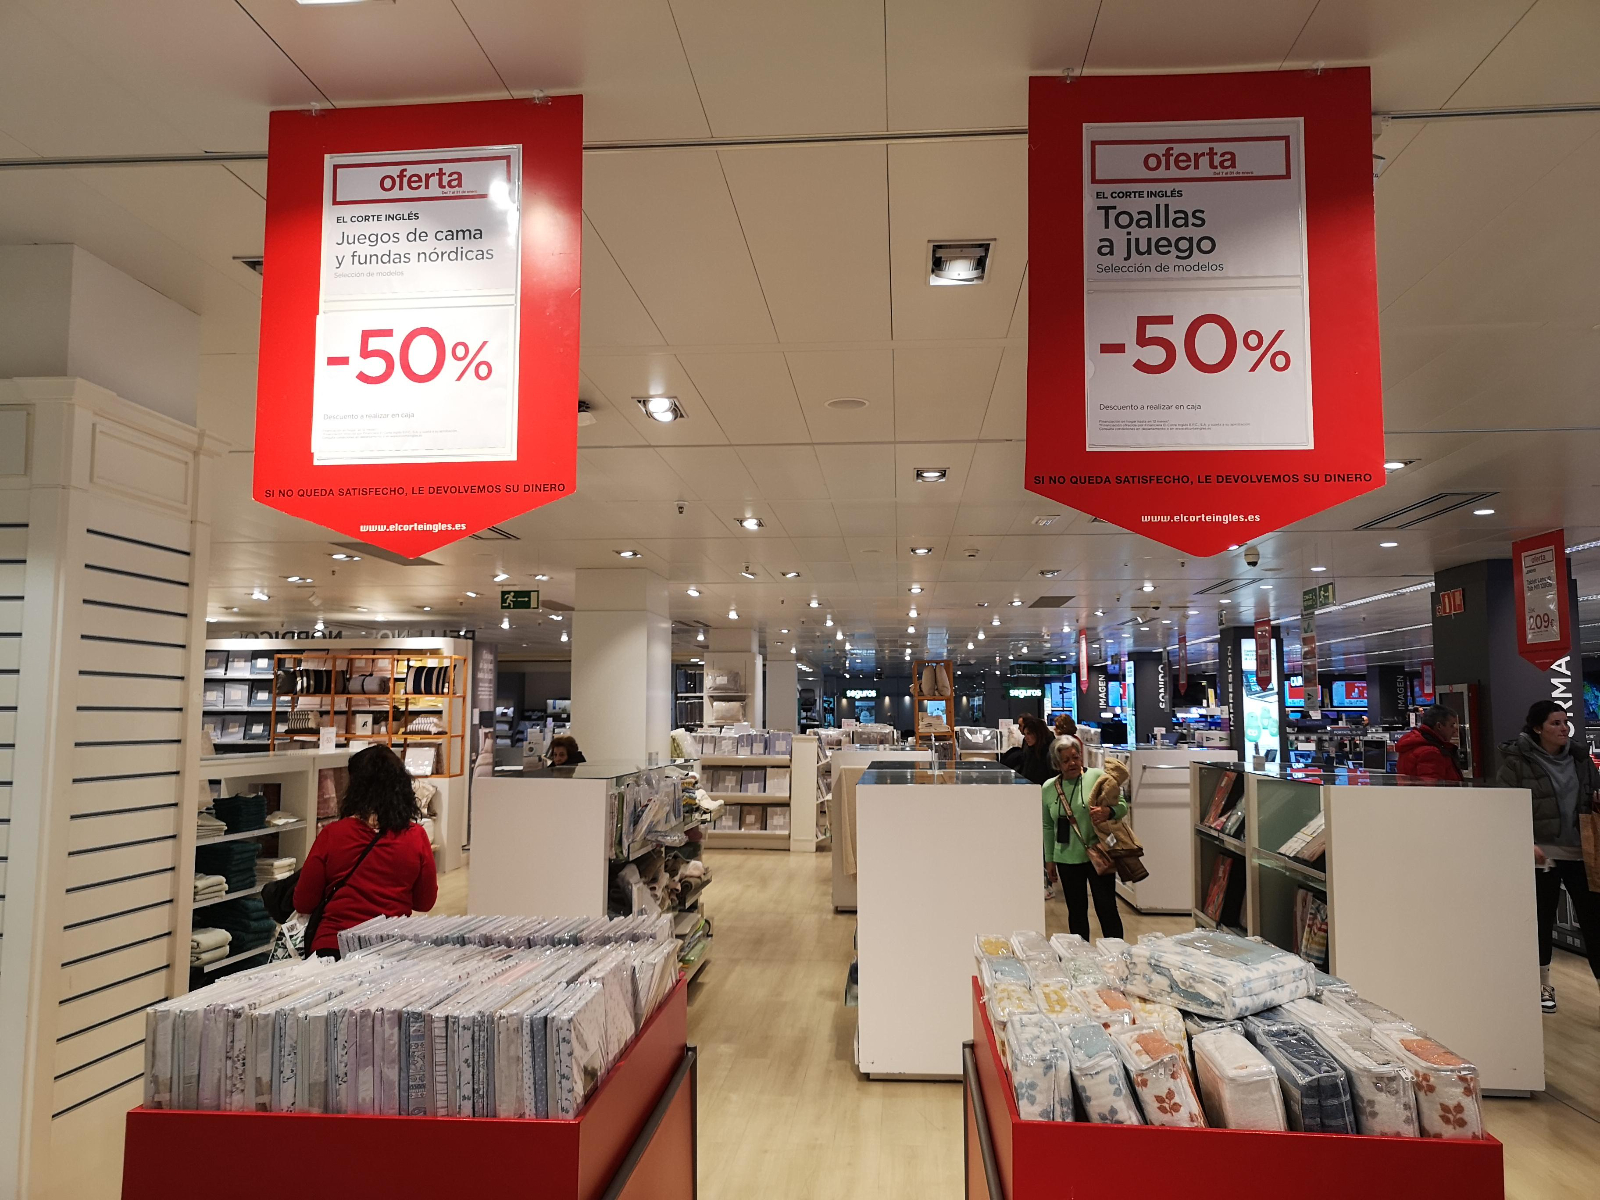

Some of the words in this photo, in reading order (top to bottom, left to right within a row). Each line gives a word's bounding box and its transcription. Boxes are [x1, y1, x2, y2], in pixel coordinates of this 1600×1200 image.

[1143, 146, 1236, 172] oferta
[379, 167, 463, 192] oferta
[1096, 191, 1108, 200] EL
[1110, 190, 1144, 199] CORTE
[1146, 188, 1183, 198] INGLÉS
[385, 211, 419, 221] INGLÉS
[1096, 203, 1206, 230] Toallas
[336, 231, 400, 246] Juegos
[406, 227, 429, 243] de
[434, 228, 483, 242] cama
[1096, 237, 1114, 256] a
[1124, 231, 1216, 261] juego
[335, 254, 345, 269] y
[350, 250, 411, 266] fundas
[417, 247, 494, 263] nórdicas
[334, 271, 365, 279] Selección
[1096, 263, 1151, 274] Selección
[1155, 263, 1170, 272] de
[1173, 262, 1224, 272] modelos
[1100, 313, 1291, 374] -50%
[326, 326, 492, 385] -50%
[1034, 475, 1046, 485] SI
[1049, 475, 1066, 485] NO
[1070, 475, 1112, 485] QUEDA
[1115, 474, 1193, 486] SATISFECHO,
[1198, 474, 1212, 484] LE
[1216, 474, 1299, 484] DEVOLVEMOS
[1302, 473, 1320, 483] SU
[1324, 473, 1372, 483] DINERO
[264, 489, 274, 498] SI
[279, 489, 294, 498] NO
[297, 488, 335, 497] QUEDA
[338, 487, 408, 497] SATISFECHO,
[412, 486, 425, 495] LE
[428, 485, 501, 495] DEVOLVEMOS
[504, 484, 519, 493] SU
[523, 483, 565, 493] DINERO
[1141, 512, 1261, 524] www.elcorteingles.es
[360, 522, 466, 532] www.elcorteingles.es
[846, 688, 876, 698] seguros
[1009, 688, 1042, 698] seguros
[1397, 675, 1405, 709] IMAGEN
